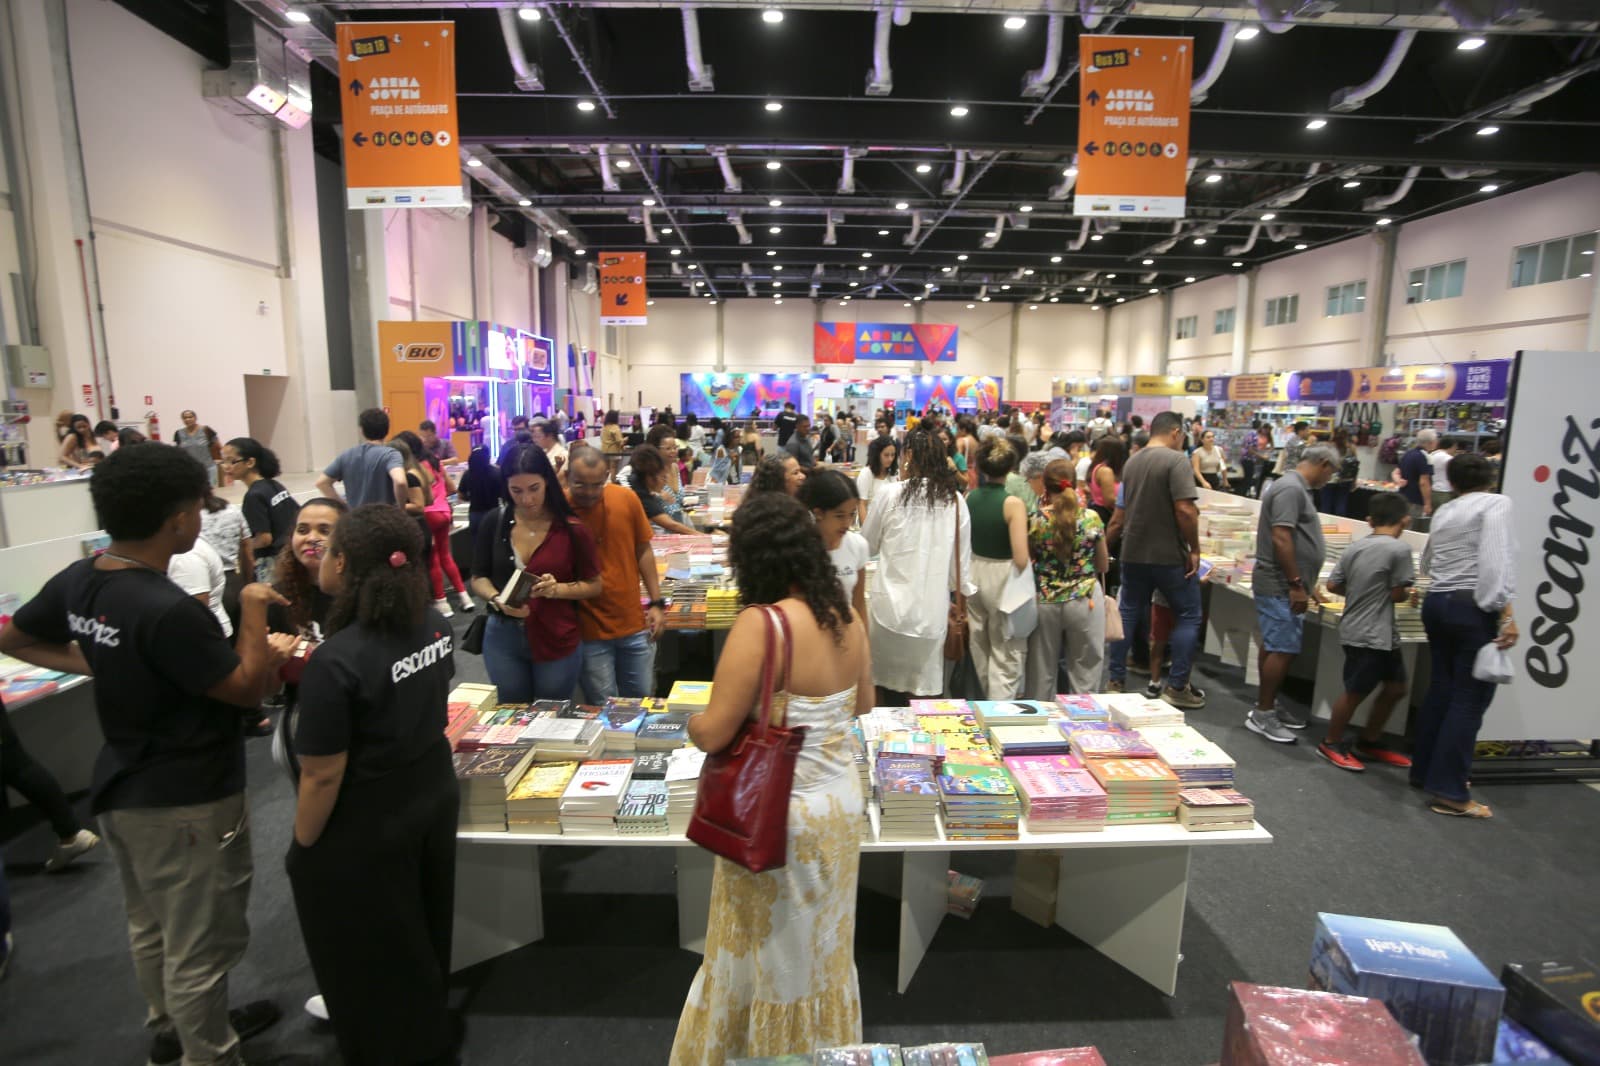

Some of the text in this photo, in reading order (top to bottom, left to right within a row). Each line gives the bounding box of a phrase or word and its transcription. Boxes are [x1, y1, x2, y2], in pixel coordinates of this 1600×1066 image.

[369, 77, 419, 88] ARENA
[370, 89, 419, 100] JOVEM
[1105, 90, 1154, 100] ARENA
[1105, 101, 1154, 111] JOVEM
[860, 330, 914, 342] ARENA
[860, 342, 913, 354] JOVEM
[391, 631, 453, 683] escariz
